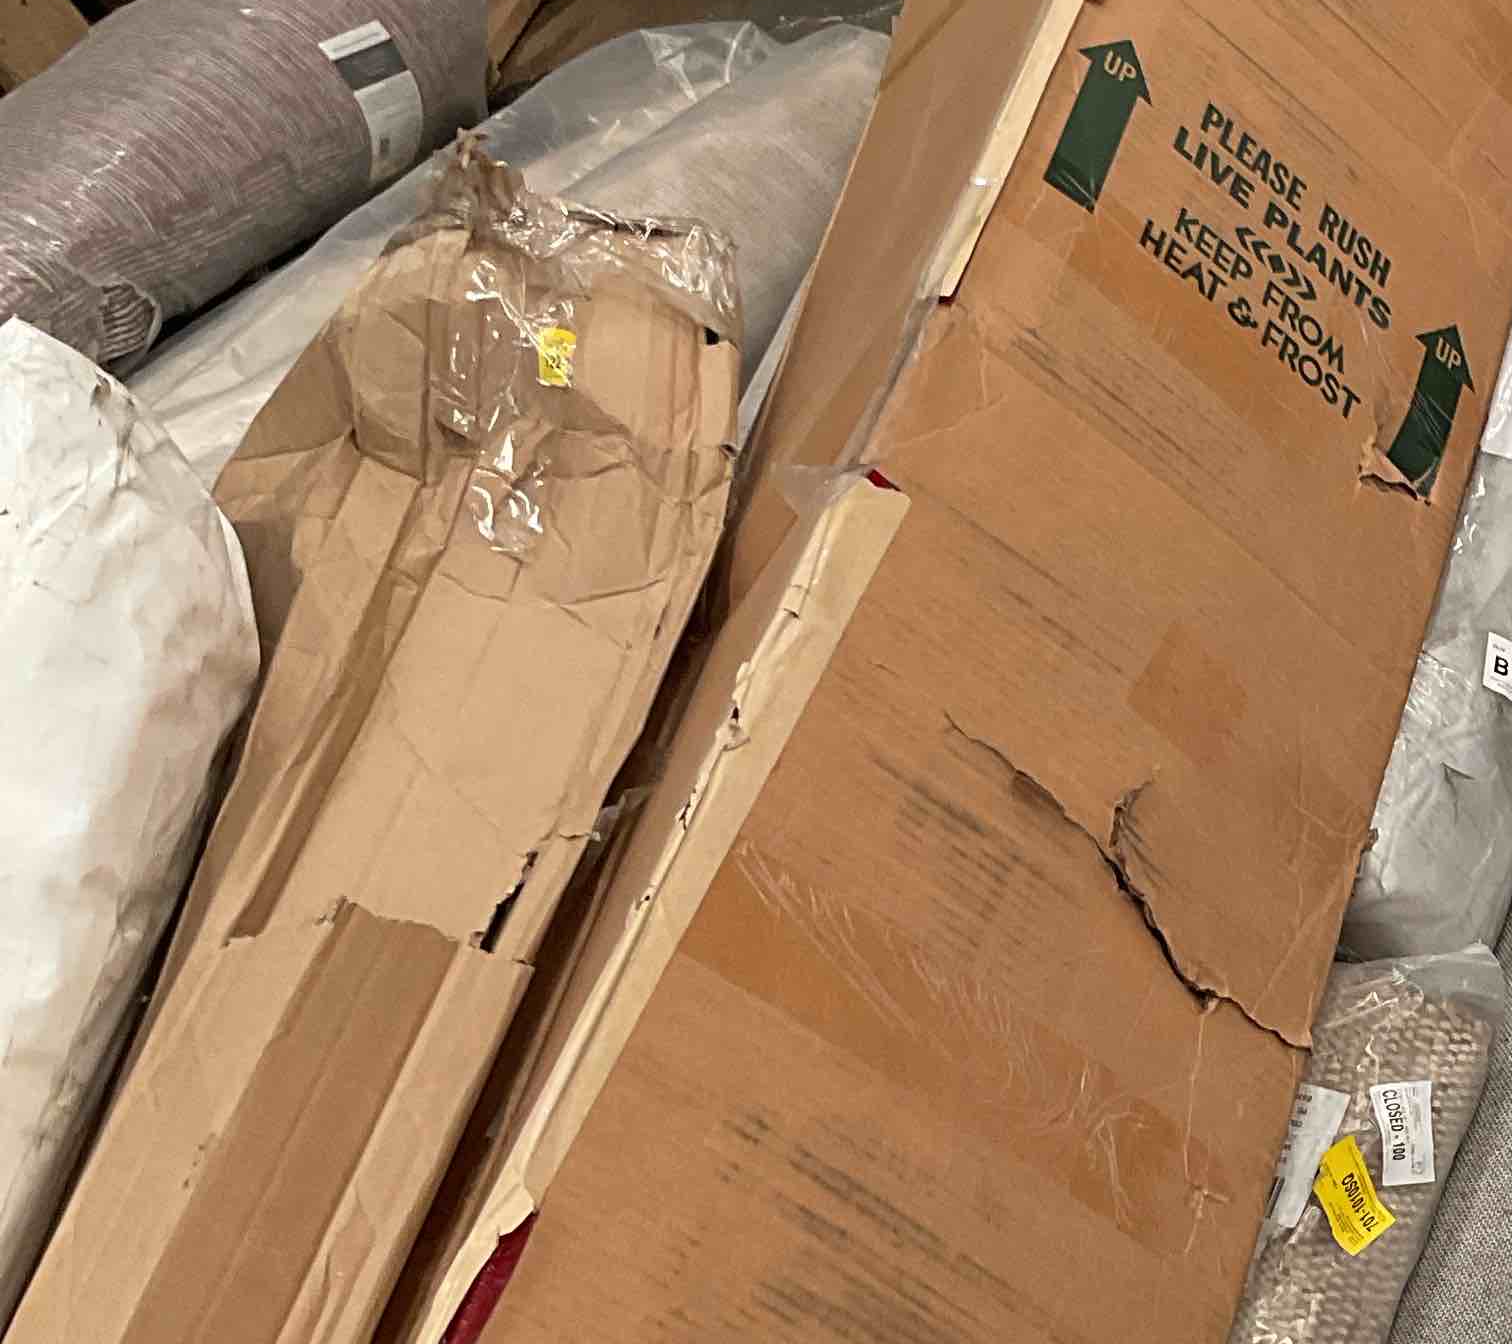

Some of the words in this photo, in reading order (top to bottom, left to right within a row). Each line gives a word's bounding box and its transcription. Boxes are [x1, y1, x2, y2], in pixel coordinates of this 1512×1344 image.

[1103, 50, 1138, 84] UP
[1200, 103, 1308, 208] PLEASE
[1317, 202, 1393, 288] RUSH
[1173, 125, 1256, 210] LIVE
[1263, 206, 1393, 331] PLANTS
[1139, 219, 1220, 304] HEAT
[1226, 296, 1259, 330] &
[1261, 323, 1362, 419] FROST
[1175, 207, 1254, 282] KEEP
[1262, 280, 1346, 373] FROM
[1435, 338, 1464, 371] UP
[1381, 1088, 1405, 1133] CLOSED
[1391, 1141, 1406, 1162] 100
[1340, 1172, 1381, 1233] 701-1010SQ
